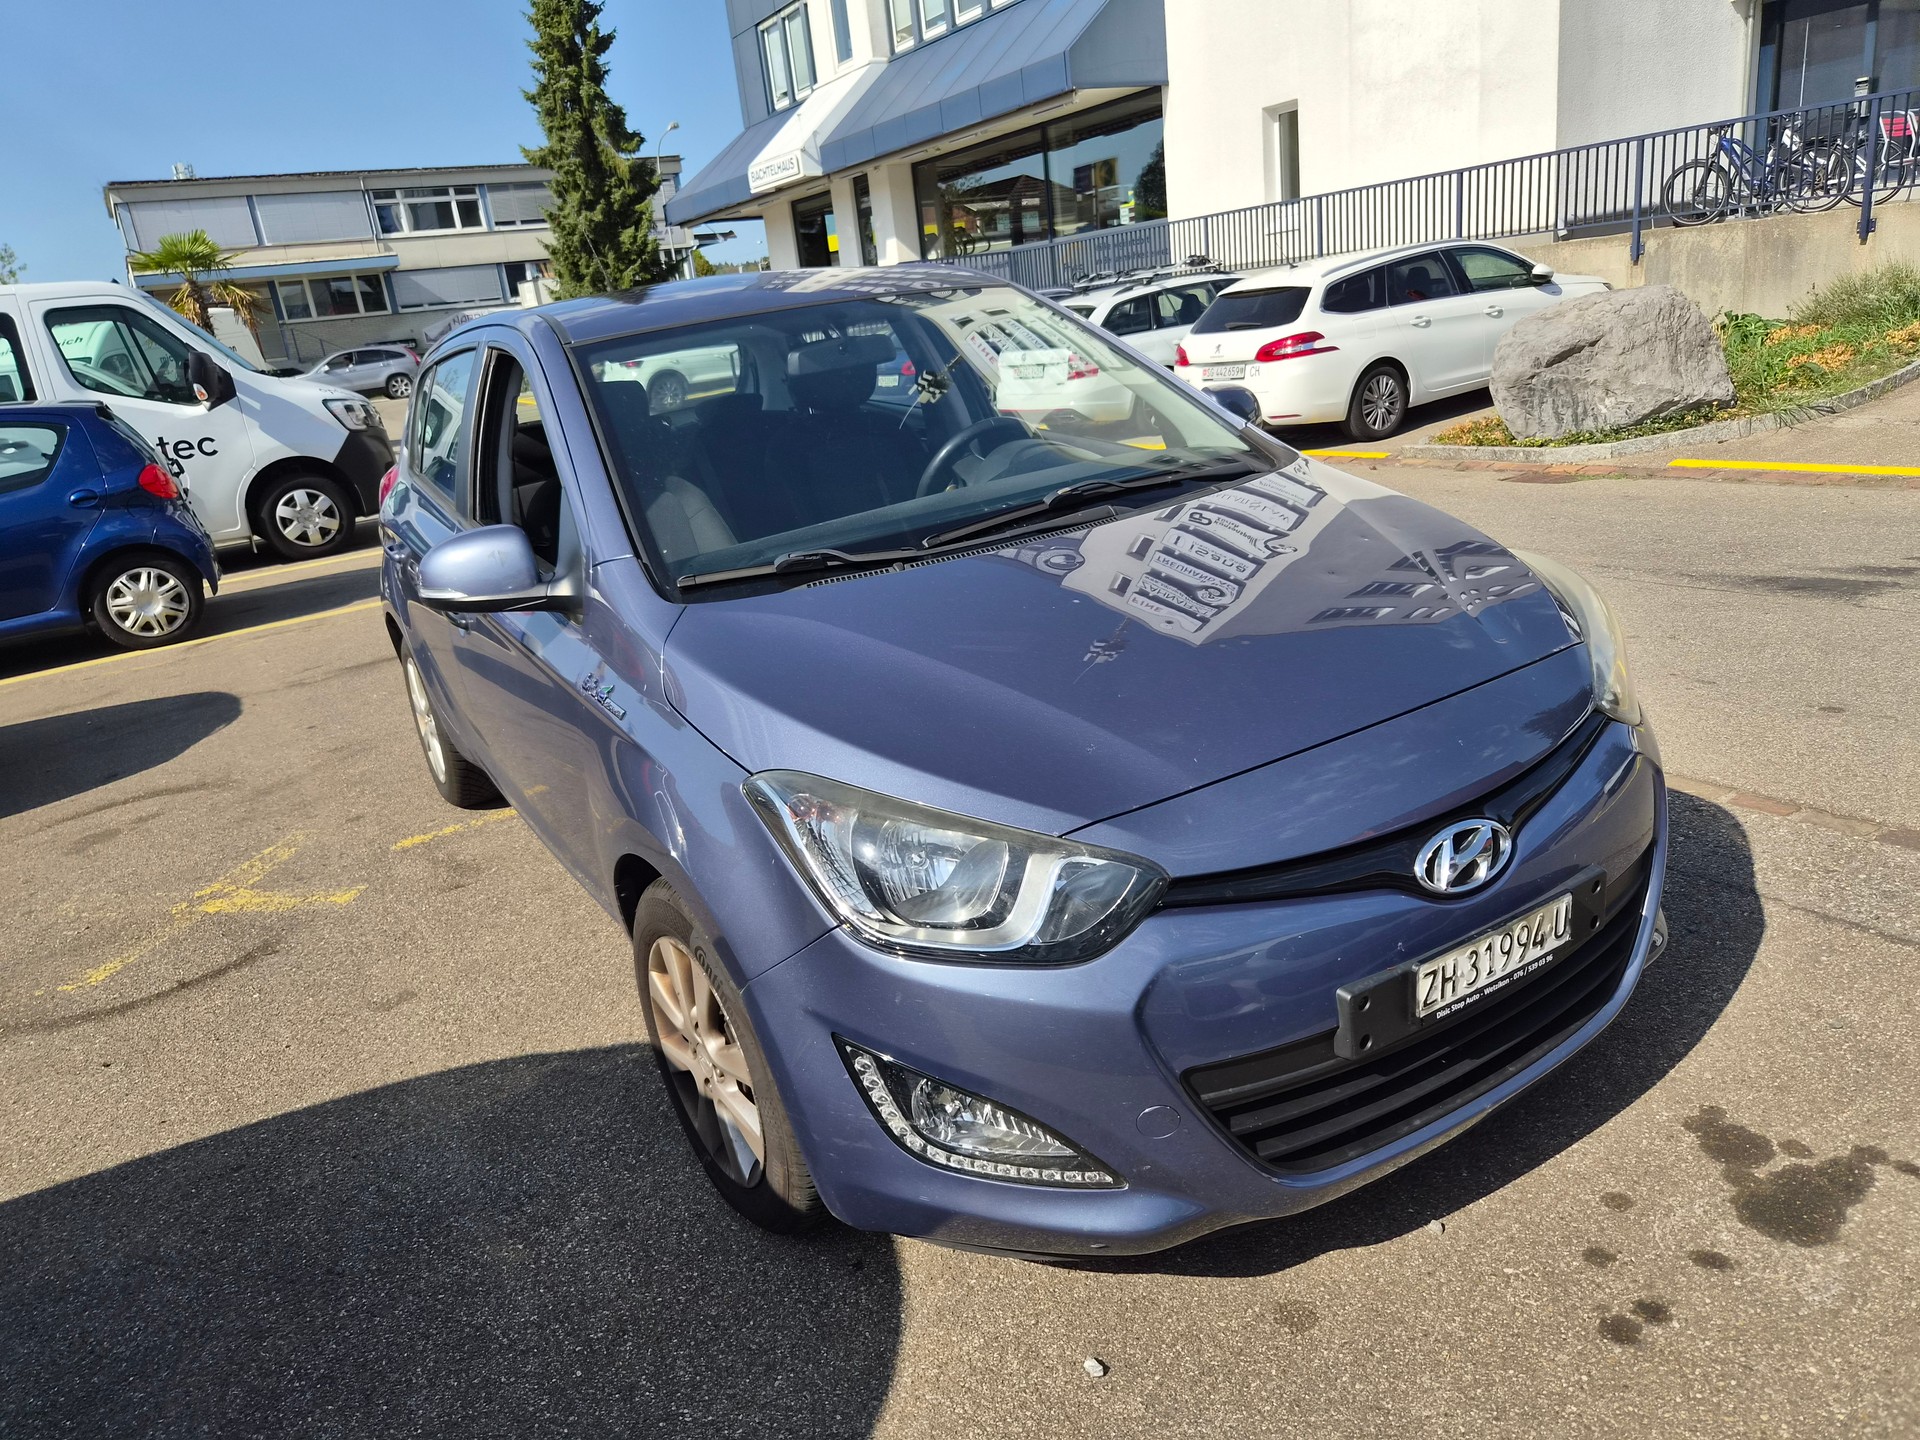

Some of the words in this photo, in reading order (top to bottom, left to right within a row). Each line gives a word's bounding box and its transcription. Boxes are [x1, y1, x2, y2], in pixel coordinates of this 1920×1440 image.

[750, 157, 795, 183] BACHTELHAUS
[1207, 368, 1214, 377] SG
[1216, 366, 1239, 377] 442659
[1249, 366, 1260, 377] CH
[1421, 959, 1458, 1010] ZH
[1464, 912, 1546, 989] 31994
[1451, 1001, 1466, 1013] Stop
[1466, 993, 1480, 1005] Auto
[1484, 977, 1510, 995] Wetzikon
